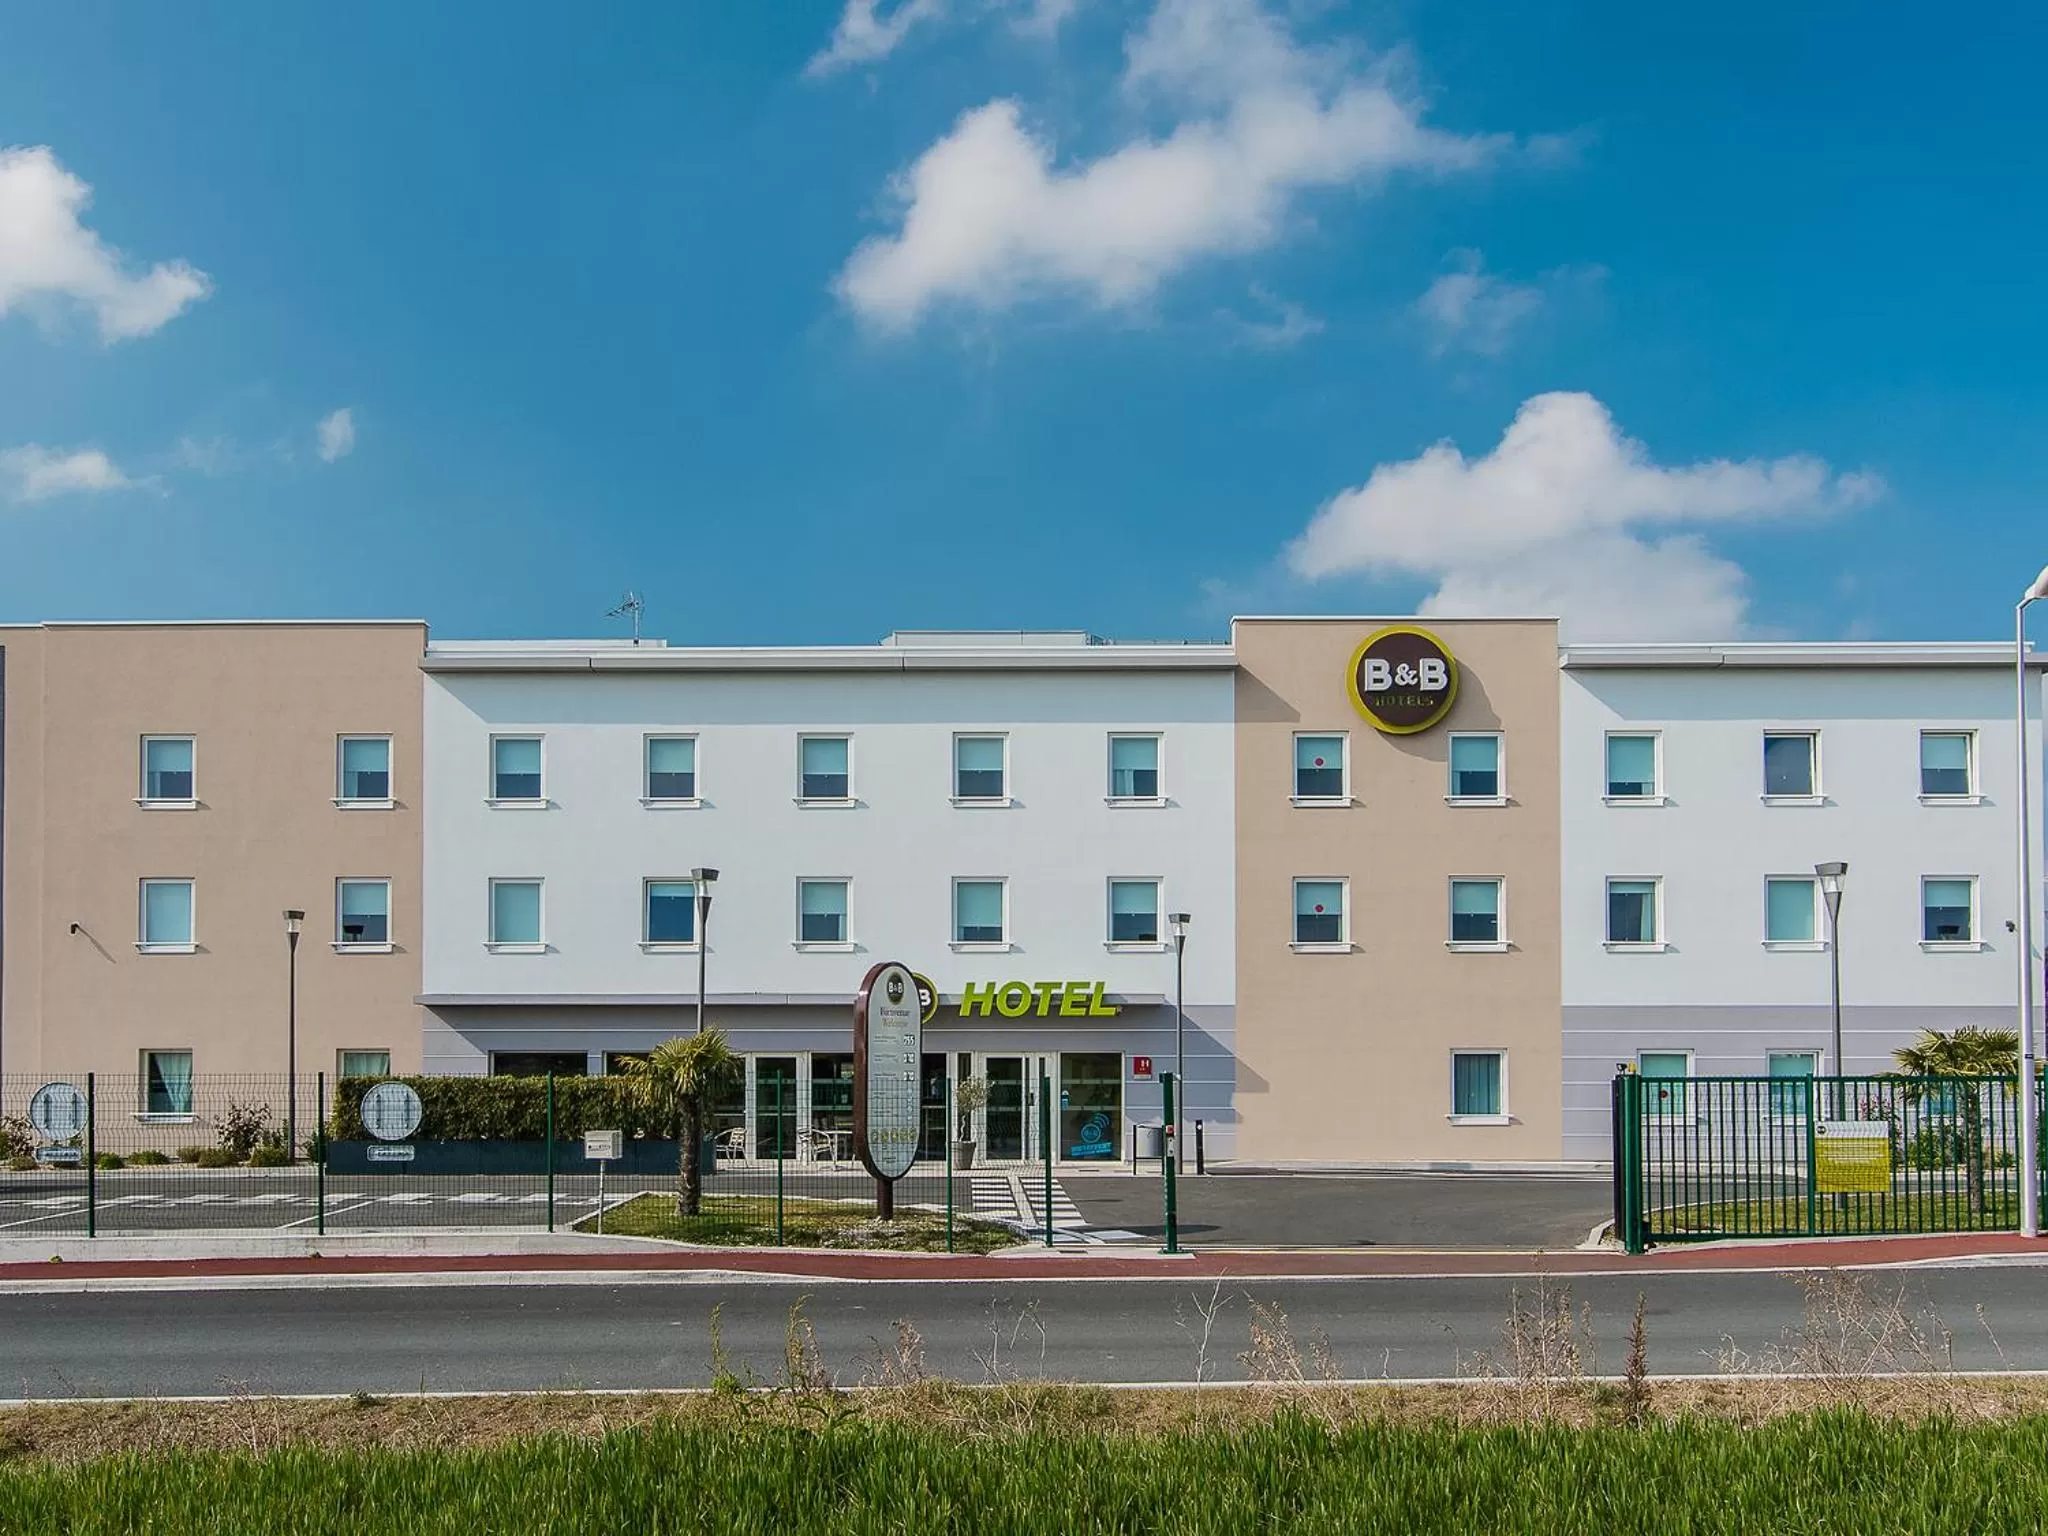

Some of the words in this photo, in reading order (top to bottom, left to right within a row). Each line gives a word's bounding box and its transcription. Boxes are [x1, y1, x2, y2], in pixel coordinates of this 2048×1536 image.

[1364, 658, 1448, 691] B&B
[1375, 695, 1434, 706] HOTELS
[888, 981, 903, 993] B&B
[959, 981, 1116, 1017] HOTEL
